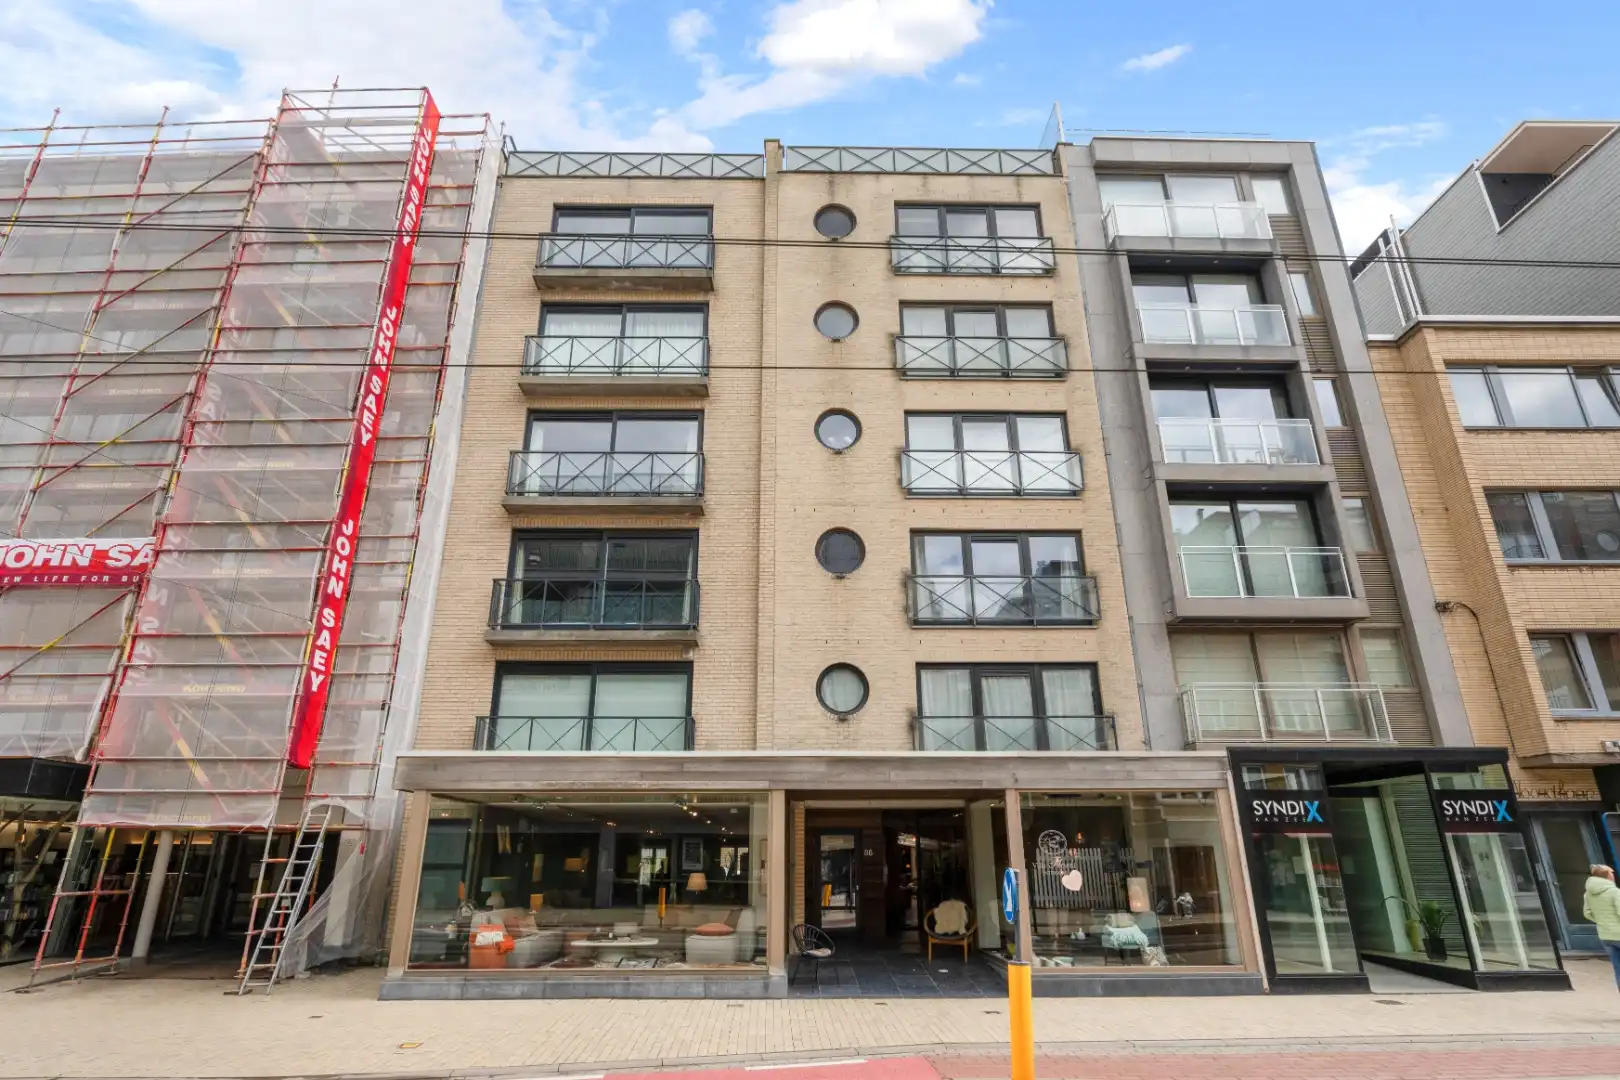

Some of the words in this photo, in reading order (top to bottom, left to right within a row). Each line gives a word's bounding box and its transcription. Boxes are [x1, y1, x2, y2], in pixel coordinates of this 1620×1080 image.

[413, 128, 432, 186] JOHN
[402, 189, 420, 247] SAEY
[374, 305, 398, 373] JOHN
[360, 375, 383, 447] SAEY
[33, 575, 69, 583] LIFE
[80, 575, 110, 583] FOR
[326, 519, 354, 599] JOHN
[310, 607, 336, 692] SAEY
[1252, 800, 1324, 823] SYNDIX
[1442, 800, 1513, 822] SYNDIX
